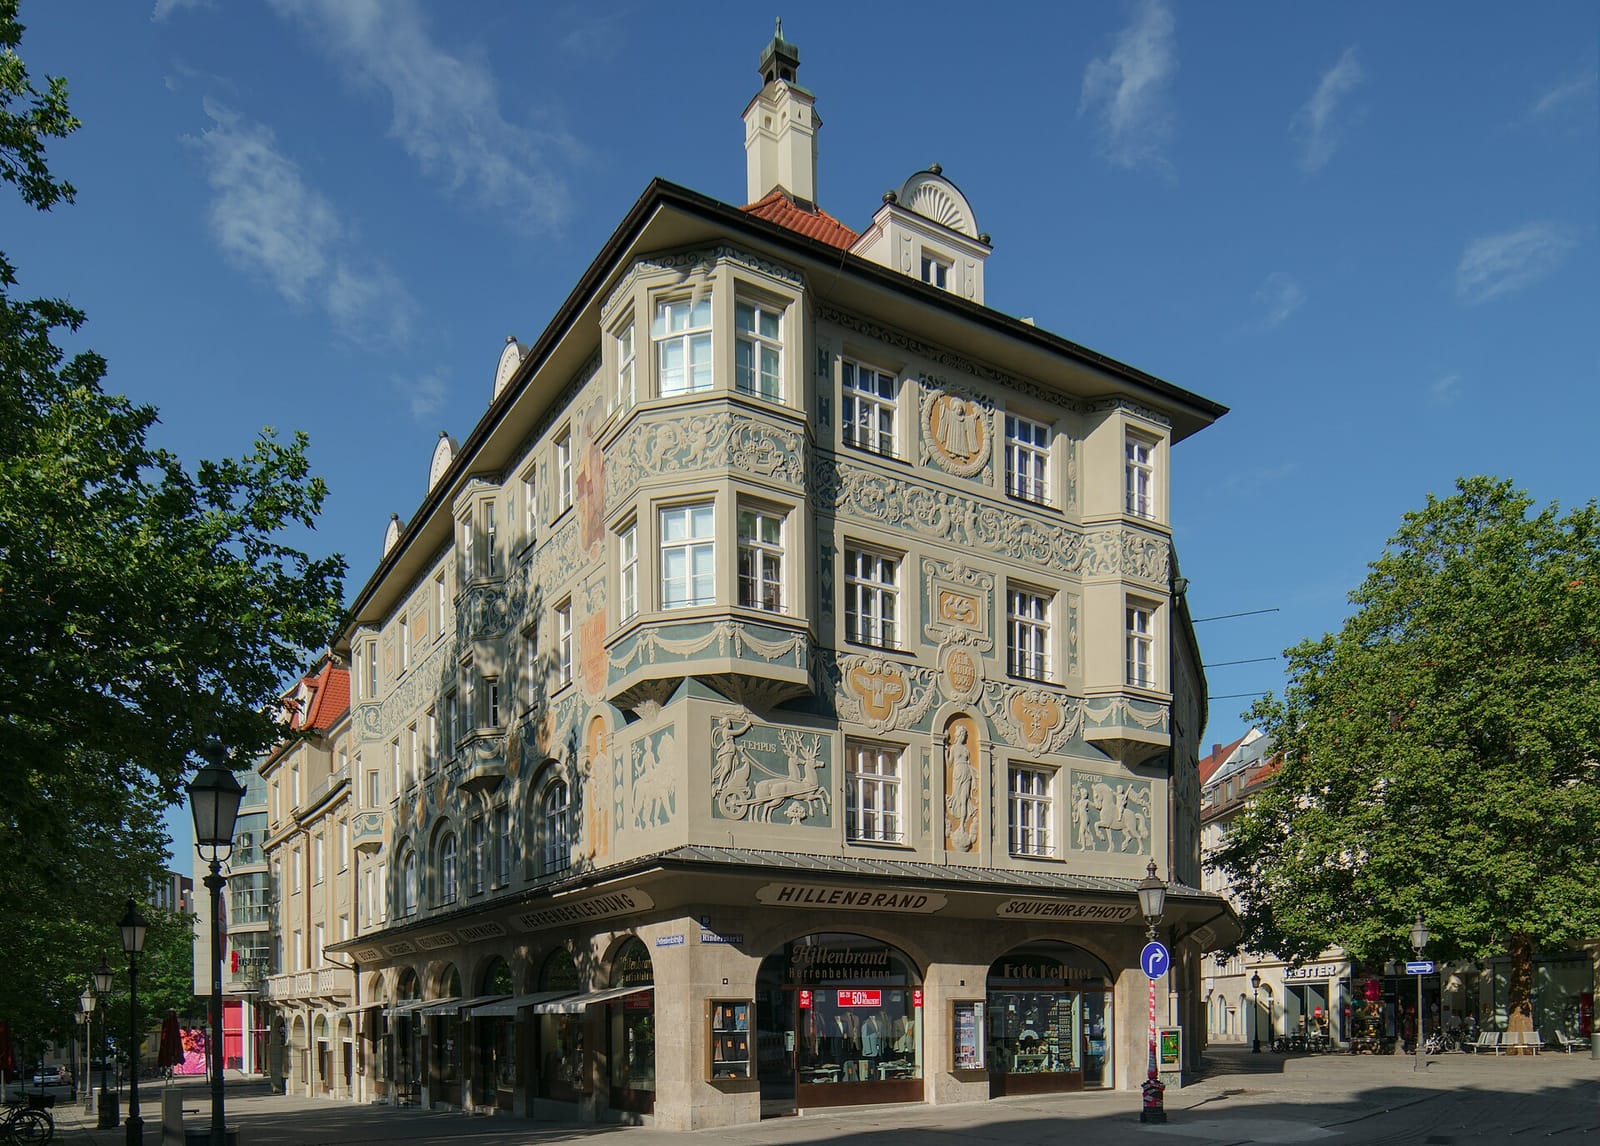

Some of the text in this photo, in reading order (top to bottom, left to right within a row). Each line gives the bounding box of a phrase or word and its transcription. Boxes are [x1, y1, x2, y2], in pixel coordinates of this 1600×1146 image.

[741, 740, 777, 753] TEMPUS
[777, 886, 928, 909] HILLENBRAND
[520, 893, 636, 929] HERRENBEKLEIDUNG
[1005, 901, 1132, 920] SOUVENIR&PHOTO
[791, 945, 888, 966] Hillenbrand
[789, 967, 890, 979] Herrenbekleidung
[1003, 963, 1035, 979] Foto
